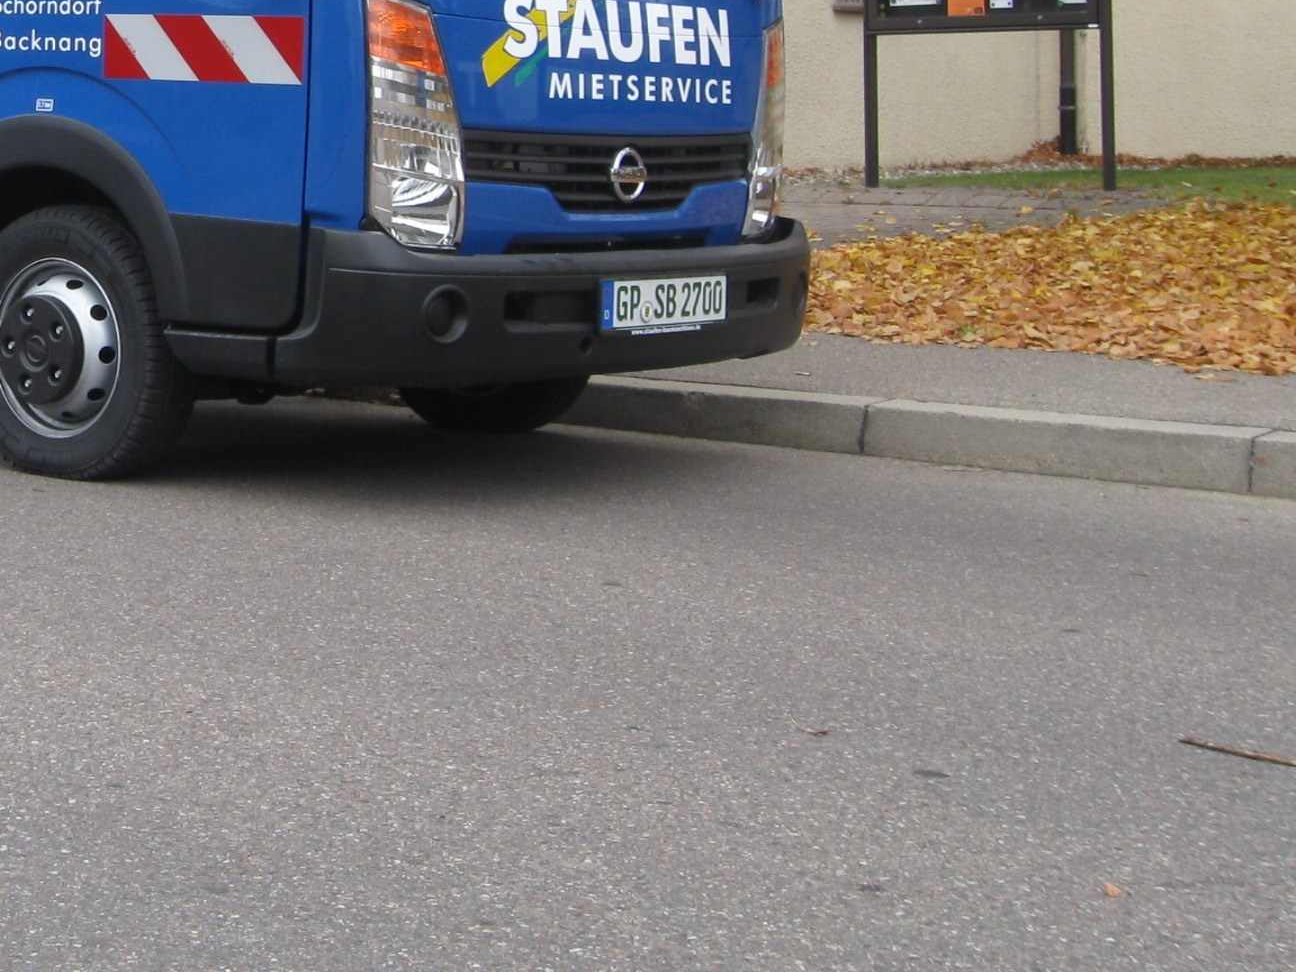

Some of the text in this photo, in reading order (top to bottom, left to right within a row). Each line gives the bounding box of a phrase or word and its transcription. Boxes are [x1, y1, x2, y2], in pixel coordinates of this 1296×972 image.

[548, 72, 732, 104] MIETSERVICE
[616, 285, 641, 322] GP
[654, 283, 677, 319] SB
[681, 280, 723, 317] 2700
